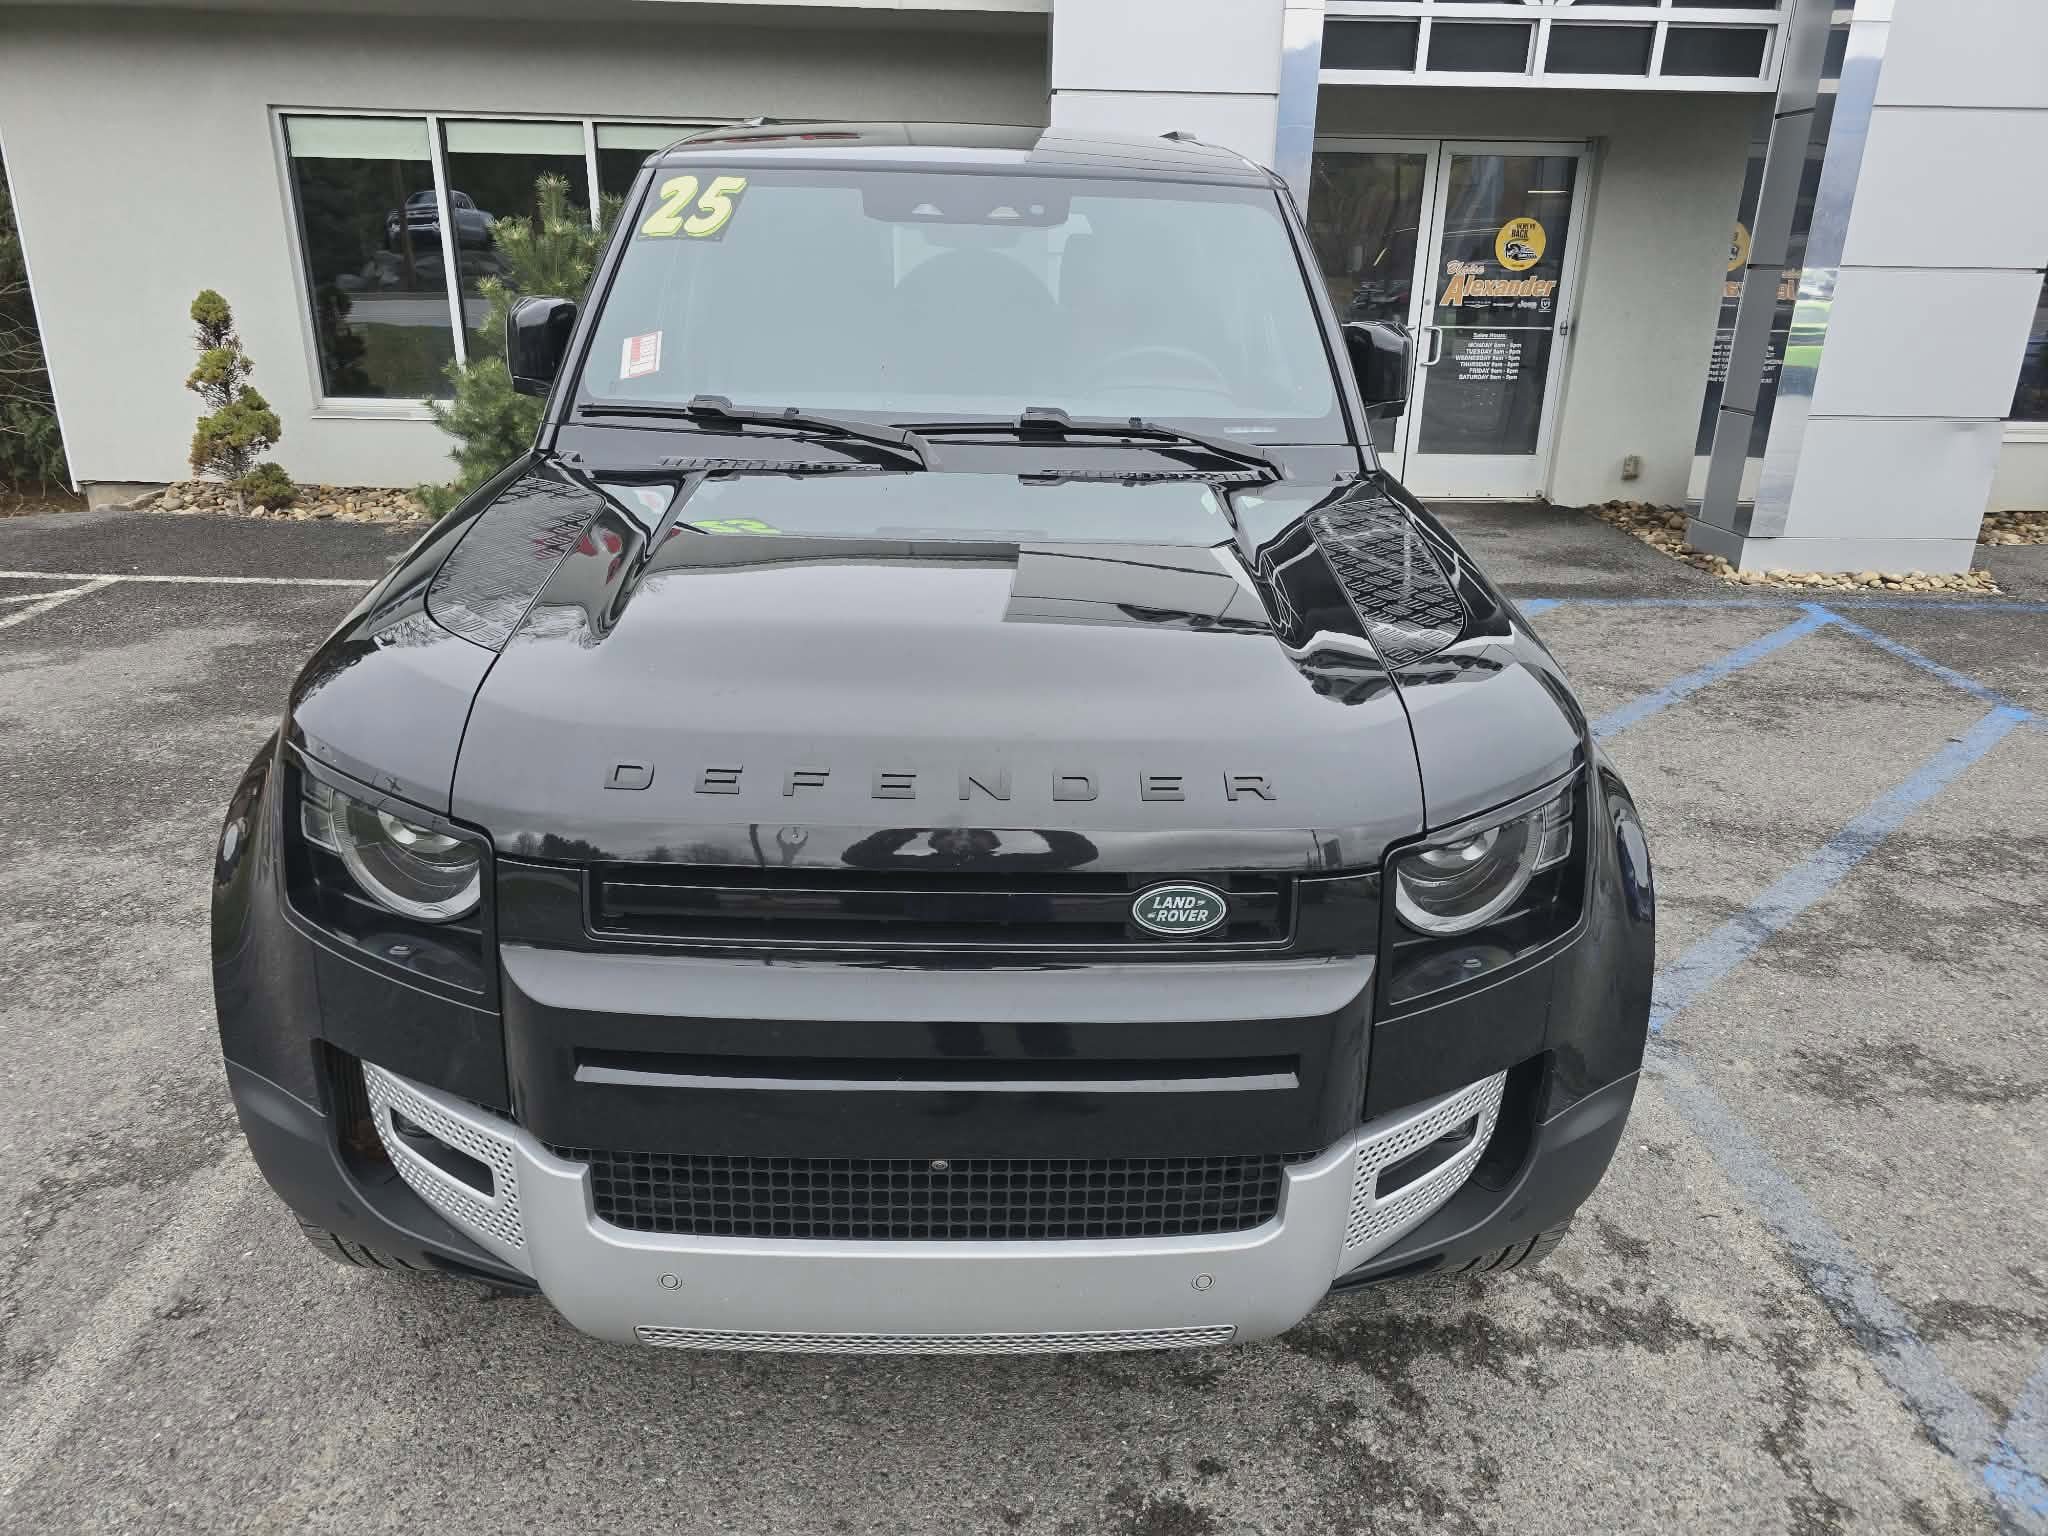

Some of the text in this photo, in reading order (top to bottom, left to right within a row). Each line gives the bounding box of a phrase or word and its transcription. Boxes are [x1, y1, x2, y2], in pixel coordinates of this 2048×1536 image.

[642, 176, 747, 237] 25
[1439, 273, 1557, 306] Alexander
[603, 759, 1277, 801] DEFENDER
[1153, 896, 1196, 909] LAND
[1156, 909, 1209, 922] ROVER
